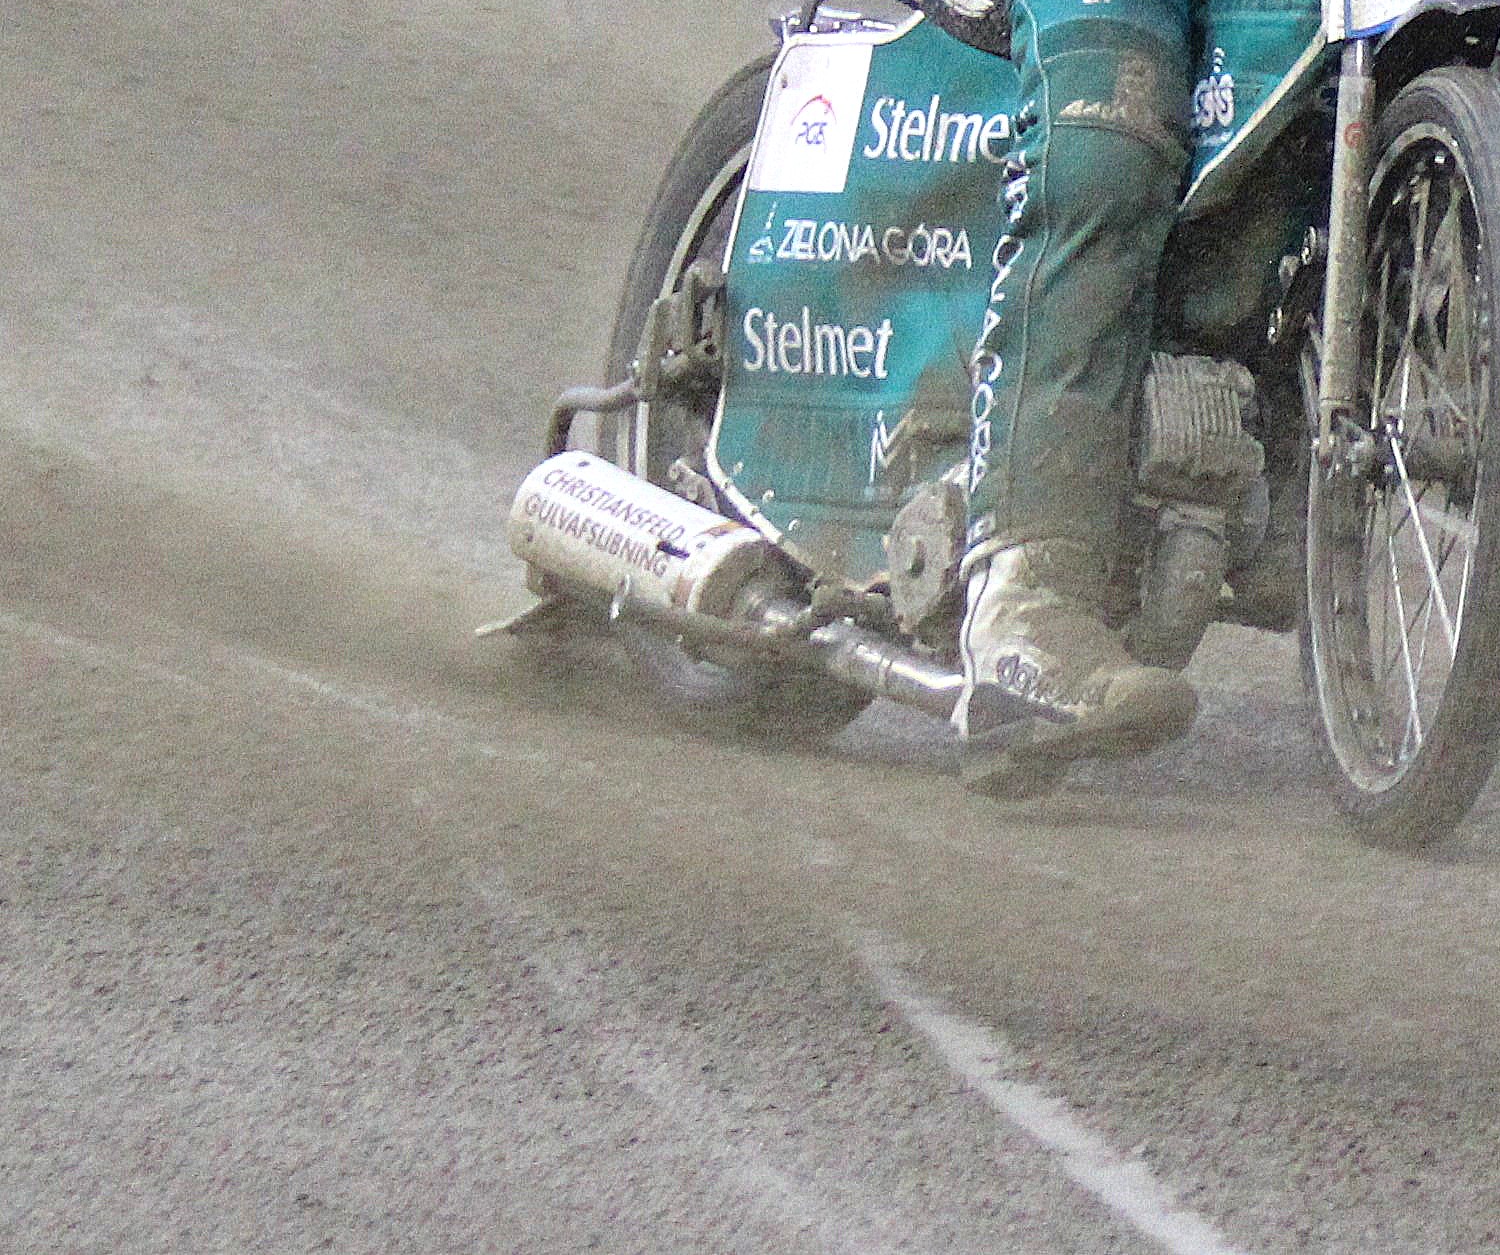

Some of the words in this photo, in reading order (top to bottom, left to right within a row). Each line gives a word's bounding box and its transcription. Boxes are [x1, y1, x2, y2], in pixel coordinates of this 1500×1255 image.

[863, 94, 1022, 164] Stelme
[882, 222, 972, 271] GÓRA
[743, 305, 894, 380] Stelmet
[543, 469, 687, 542] CHRISTIANSFELD
